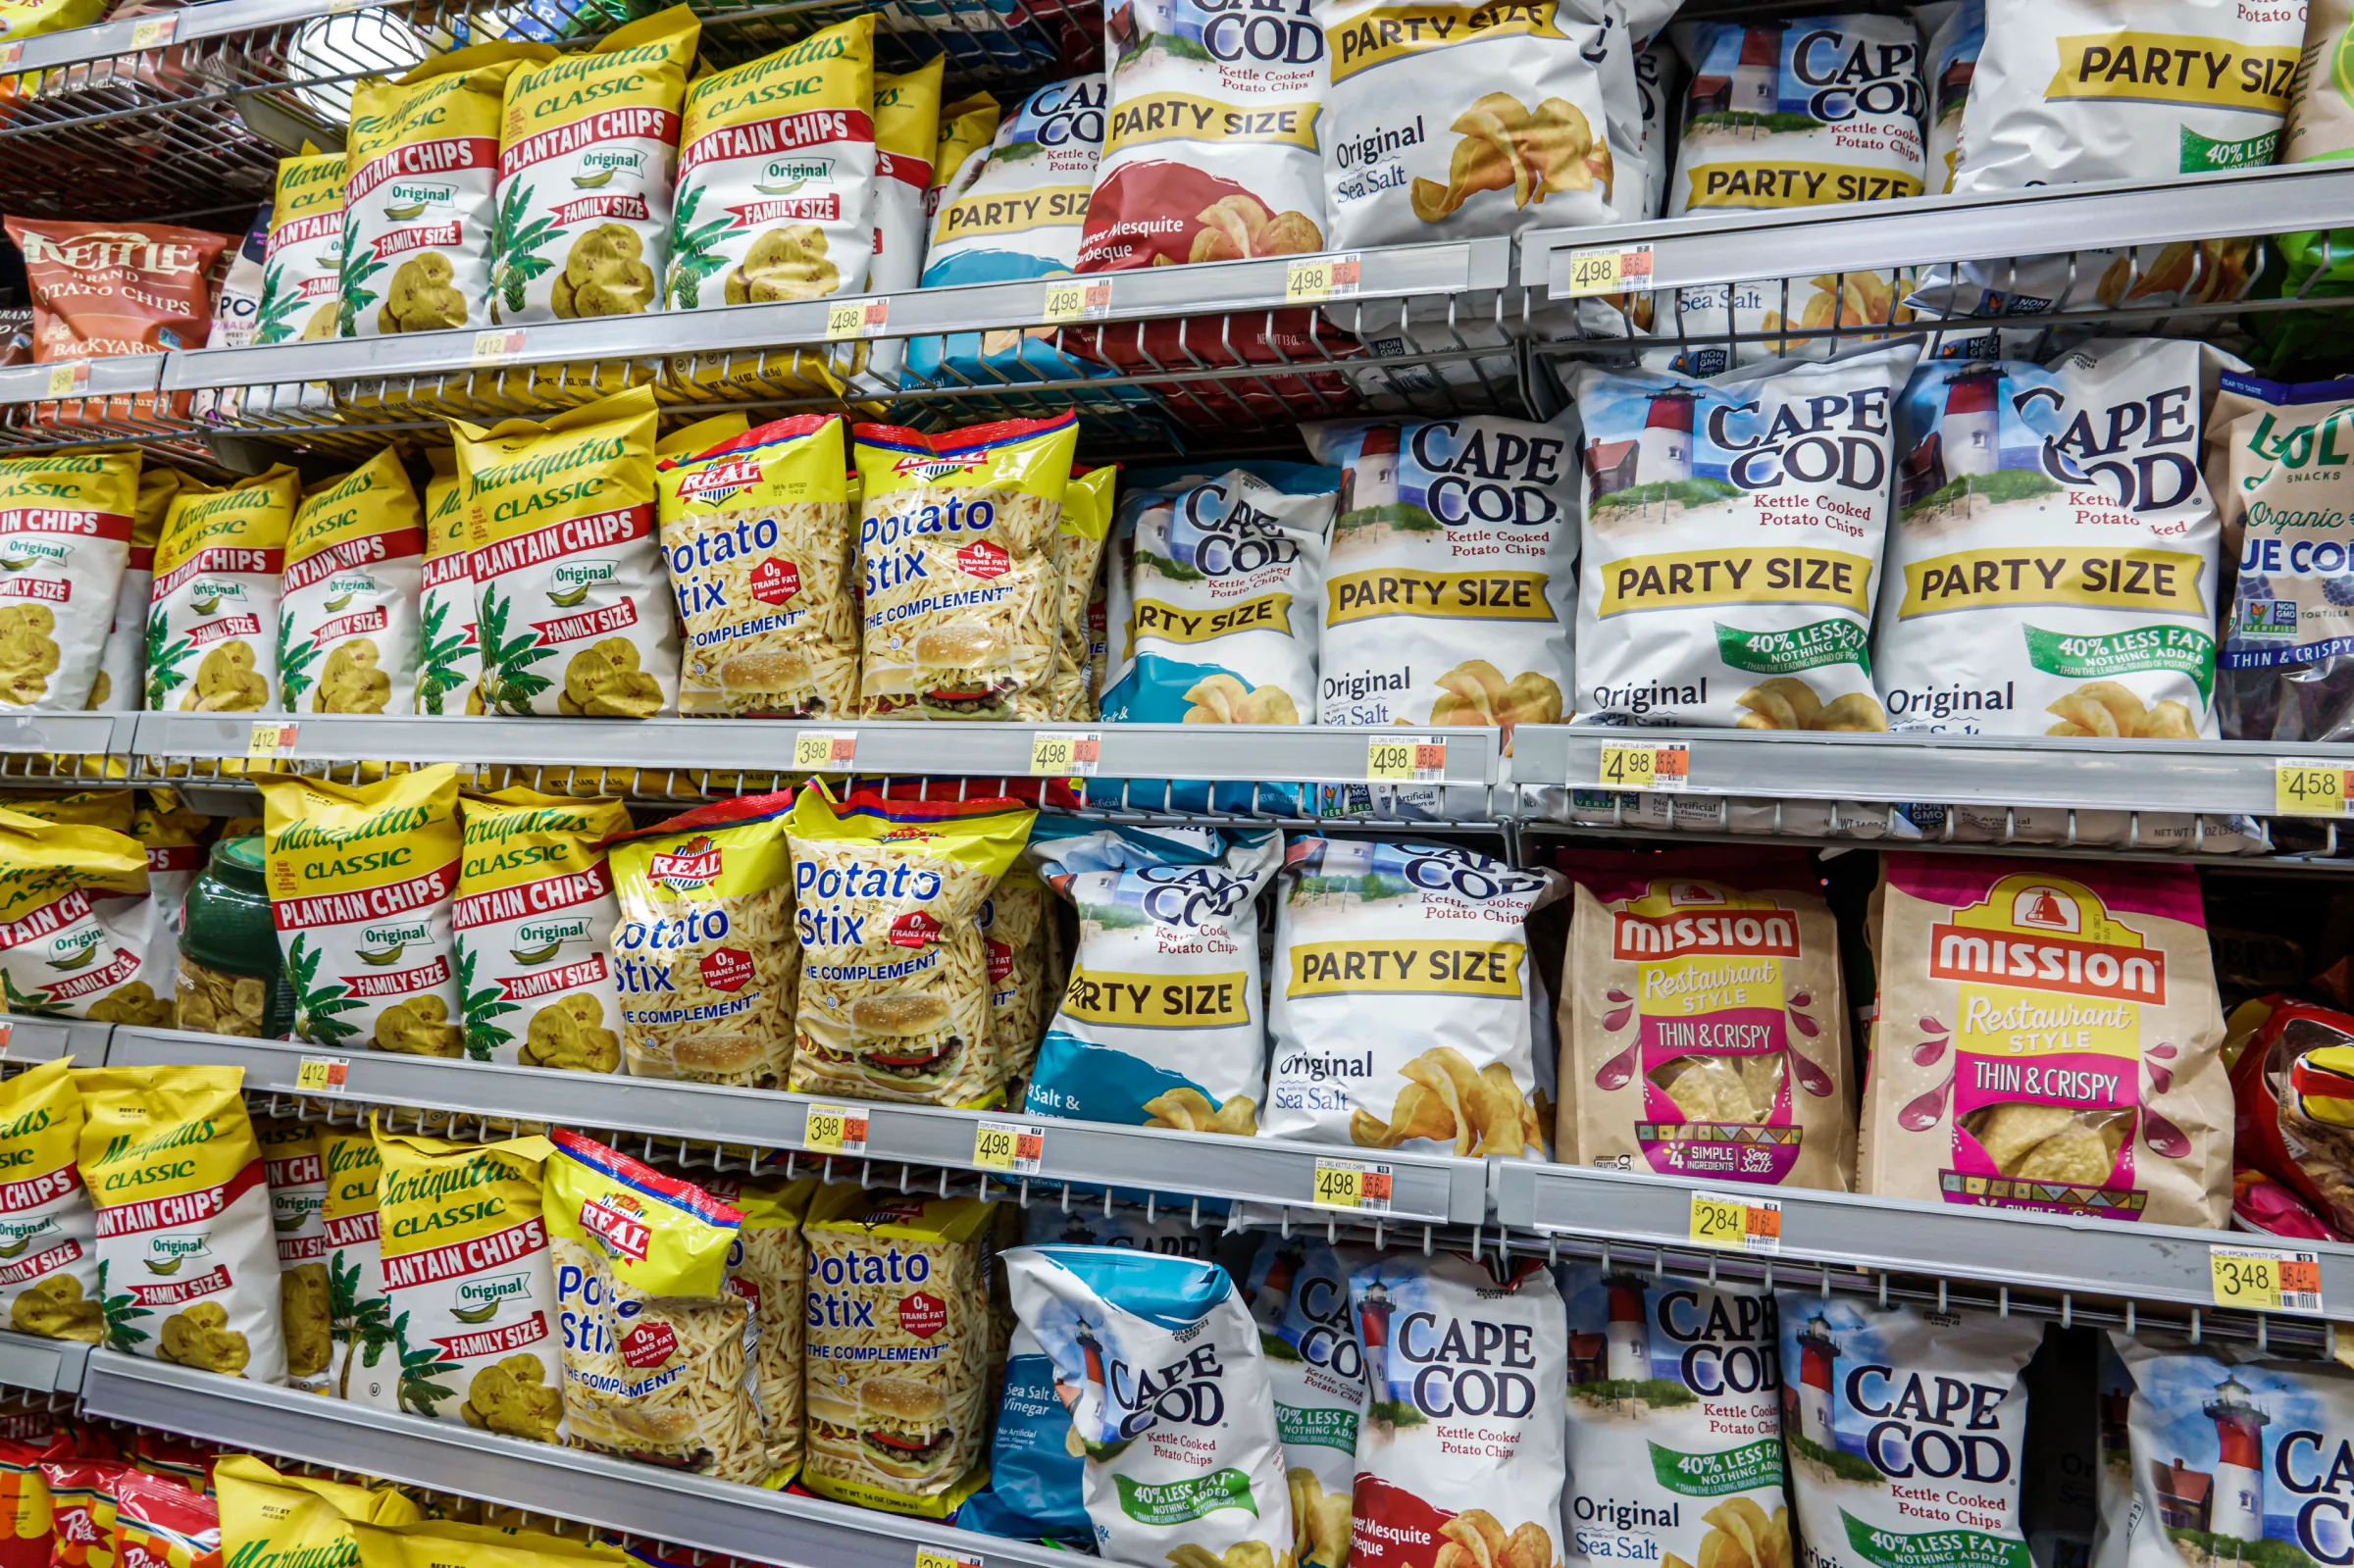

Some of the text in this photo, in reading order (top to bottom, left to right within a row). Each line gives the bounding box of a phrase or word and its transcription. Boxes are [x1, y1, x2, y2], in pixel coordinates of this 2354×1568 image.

[1203, 16, 1324, 64] COD
[1343, 5, 1544, 64] PARTY SIZE
[508, 41, 670, 106] Mariquitas
[1218, 65, 1315, 81] Kettle Cooked
[2079, 45, 2231, 89] PARTY
[535, 75, 643, 118] CLASSIC
[1221, 78, 1309, 93] Potato Chips
[1112, 101, 1297, 141] PARTY SIZE
[504, 119, 592, 170] PLANTAIN
[597, 111, 665, 141] CHIPS
[1337, 116, 1425, 169] Original
[1835, 134, 1920, 163] Potato Chips
[583, 151, 639, 171] Original
[769, 161, 829, 179] Original
[1338, 165, 1407, 203] Sea Salt
[1707, 171, 1911, 201] PARTY SIZE
[563, 201, 644, 226] FAMILY SIZE
[744, 199, 834, 223] FAMILY SIZE
[19, 228, 199, 276] KETTLE
[73, 270, 138, 282] BRAND
[1287, 270, 1323, 296] $498
[1571, 260, 1612, 288] $498
[122, 287, 190, 316] CHIPS
[1708, 386, 1889, 451] CAPE
[469, 435, 624, 501] Mariquitas
[1411, 421, 1563, 486] CAPE
[1729, 436, 1886, 490] COD
[683, 461, 759, 492] REAL
[2286, 471, 2340, 483] SNACKS
[494, 479, 603, 522] CLASSIC
[1426, 476, 1559, 527] COD
[26, 512, 98, 533] CHIPS
[2247, 501, 2343, 535] Organic
[9, 538, 66, 560] Original
[475, 511, 635, 577] PLANTAIN CHIPS
[1447, 530, 1550, 544] Kettle Cooked
[1452, 544, 1546, 557] Potato Chips
[203, 549, 267, 574] CHIPS
[556, 564, 612, 585] Original
[764, 561, 781, 578] 0g
[192, 579, 241, 596] Original
[751, 574, 798, 589] TRANS FAT
[757, 583, 798, 599] per serving
[1618, 558, 1853, 599] PARTY SIZE
[1920, 558, 2176, 601] PARTY SIZE
[1339, 579, 1532, 611] PARTY SIZE
[2277, 601, 2295, 610] NON
[546, 604, 634, 641] FAMILY SIZE
[2300, 609, 2350, 620] TORTILLA
[197, 615, 256, 645] FAMILY SIZE
[2059, 632, 2161, 657] 40% LESS
[2084, 648, 2205, 667] NOTHING ADDED
[2232, 640, 2351, 667] THIN & CRISPY
[1323, 666, 1410, 702] Original
[1886, 681, 2014, 718] Original
[1033, 742, 1066, 769] $498
[1368, 747, 1407, 775] $498
[2281, 770, 2336, 801] $458
[304, 847, 411, 881] CLASSIC
[651, 852, 720, 879] REAL
[796, 862, 943, 900] Potato
[280, 873, 445, 930] PLANTAIN CHIPS
[365, 924, 426, 945] Original
[798, 905, 865, 945] Stix
[1303, 949, 1508, 984] PARTY SIZE
[1645, 960, 1776, 1000] Restaurant
[1682, 992, 1747, 1013] STYLE
[1964, 996, 2132, 1035] Restaurant
[1657, 1023, 1771, 1049] THIN & CRISPY
[2008, 1032, 2091, 1053] STYLE
[1973, 1061, 2119, 1103] THIN & CRISPY
[1276, 1087, 1350, 1112] Sea Salt
[808, 1116, 839, 1140] $398
[977, 1132, 1010, 1160] $498
[1691, 1146, 1733, 1161] SIMPLE
[105, 1159, 196, 1191] CLASSIC
[1687, 1161, 1734, 1171] INGREDIENTS
[1315, 1171, 1354, 1200] $498
[579, 1202, 650, 1261] REAL
[1695, 1204, 1738, 1236] $284
[152, 1238, 203, 1256] Original
[142, 1272, 229, 1307] FAMILY SIZE
[2214, 1261, 2270, 1295] $348
[1397, 1311, 1537, 1370] CAPE
[1006, 1382, 1050, 1401] Sea Salt
[1411, 1365, 1536, 1420] COD
[1844, 1365, 2009, 1431] CAPE
[1003, 1398, 1050, 1418] Vinegar
[1436, 1425, 1520, 1443] Kettle Cooked
[1442, 1442, 1514, 1459] Potato Chips
[1866, 1420, 2012, 1484] COD
[1134, 1479, 1193, 1504] 40% LESS
[1891, 1485, 2007, 1511] Kettle Cooked
[1573, 1496, 1679, 1529] Original
[1363, 1518, 1432, 1546] Mesquite
[1575, 1532, 1659, 1560] Sea Salt
